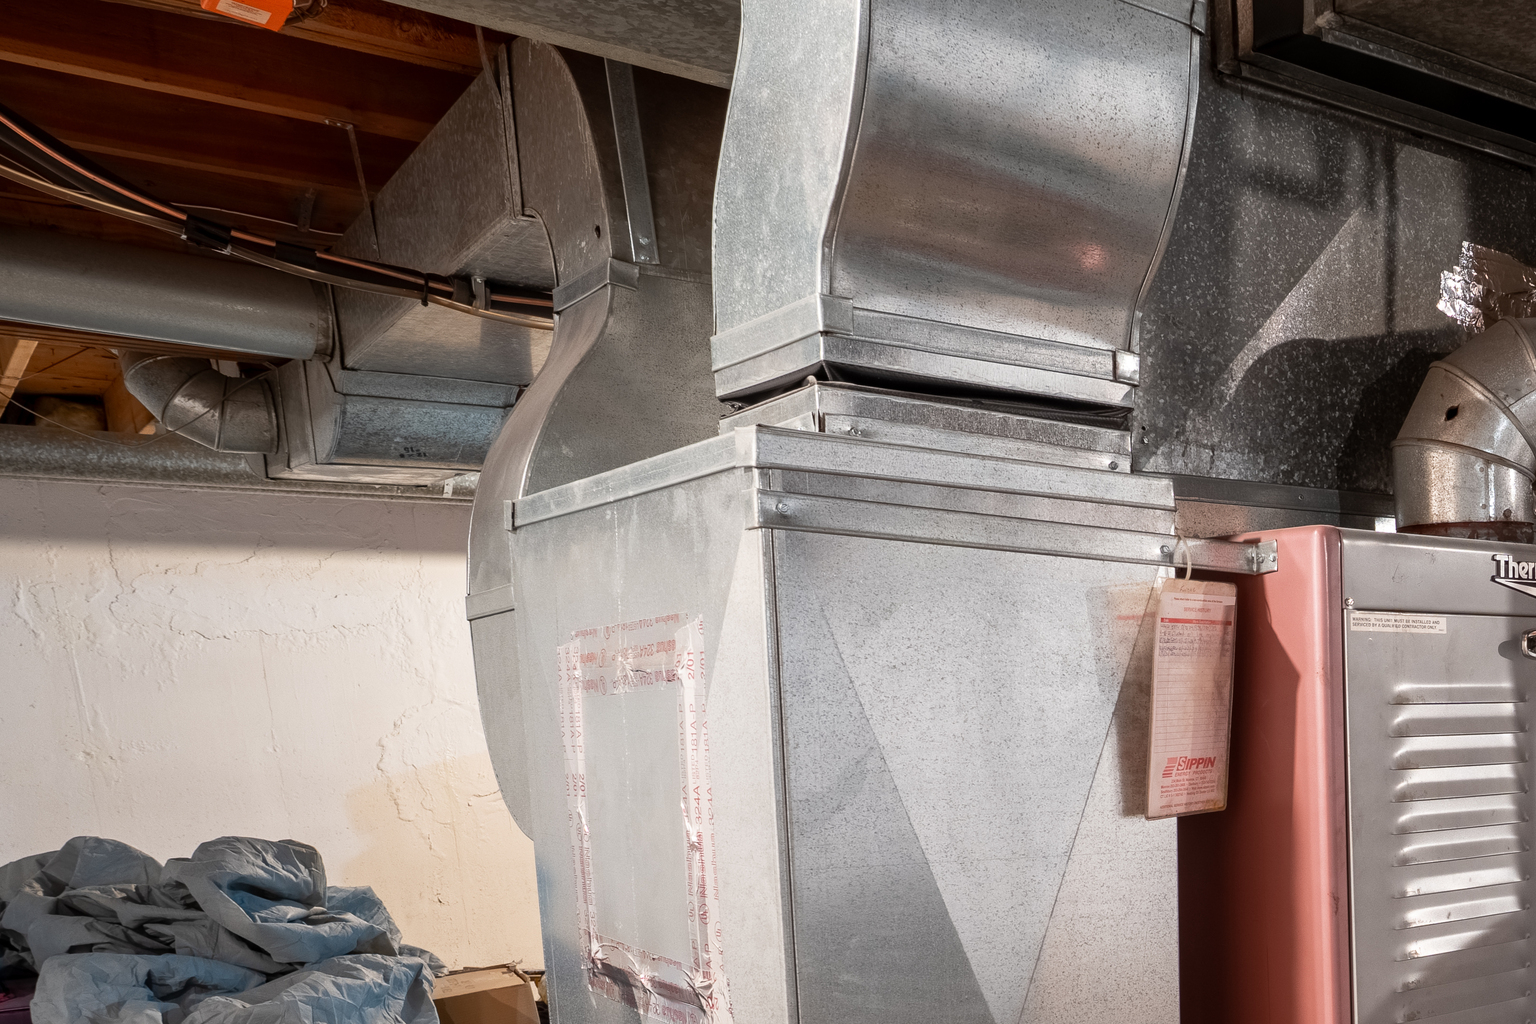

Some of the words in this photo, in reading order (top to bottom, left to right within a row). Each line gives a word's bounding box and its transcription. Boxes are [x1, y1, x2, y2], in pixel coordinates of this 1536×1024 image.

[687, 651, 695, 680] 2/01
[689, 703, 698, 752] 181A-P
[1176, 756, 1216, 772] SIPPIN
[692, 785, 703, 825] 324A
